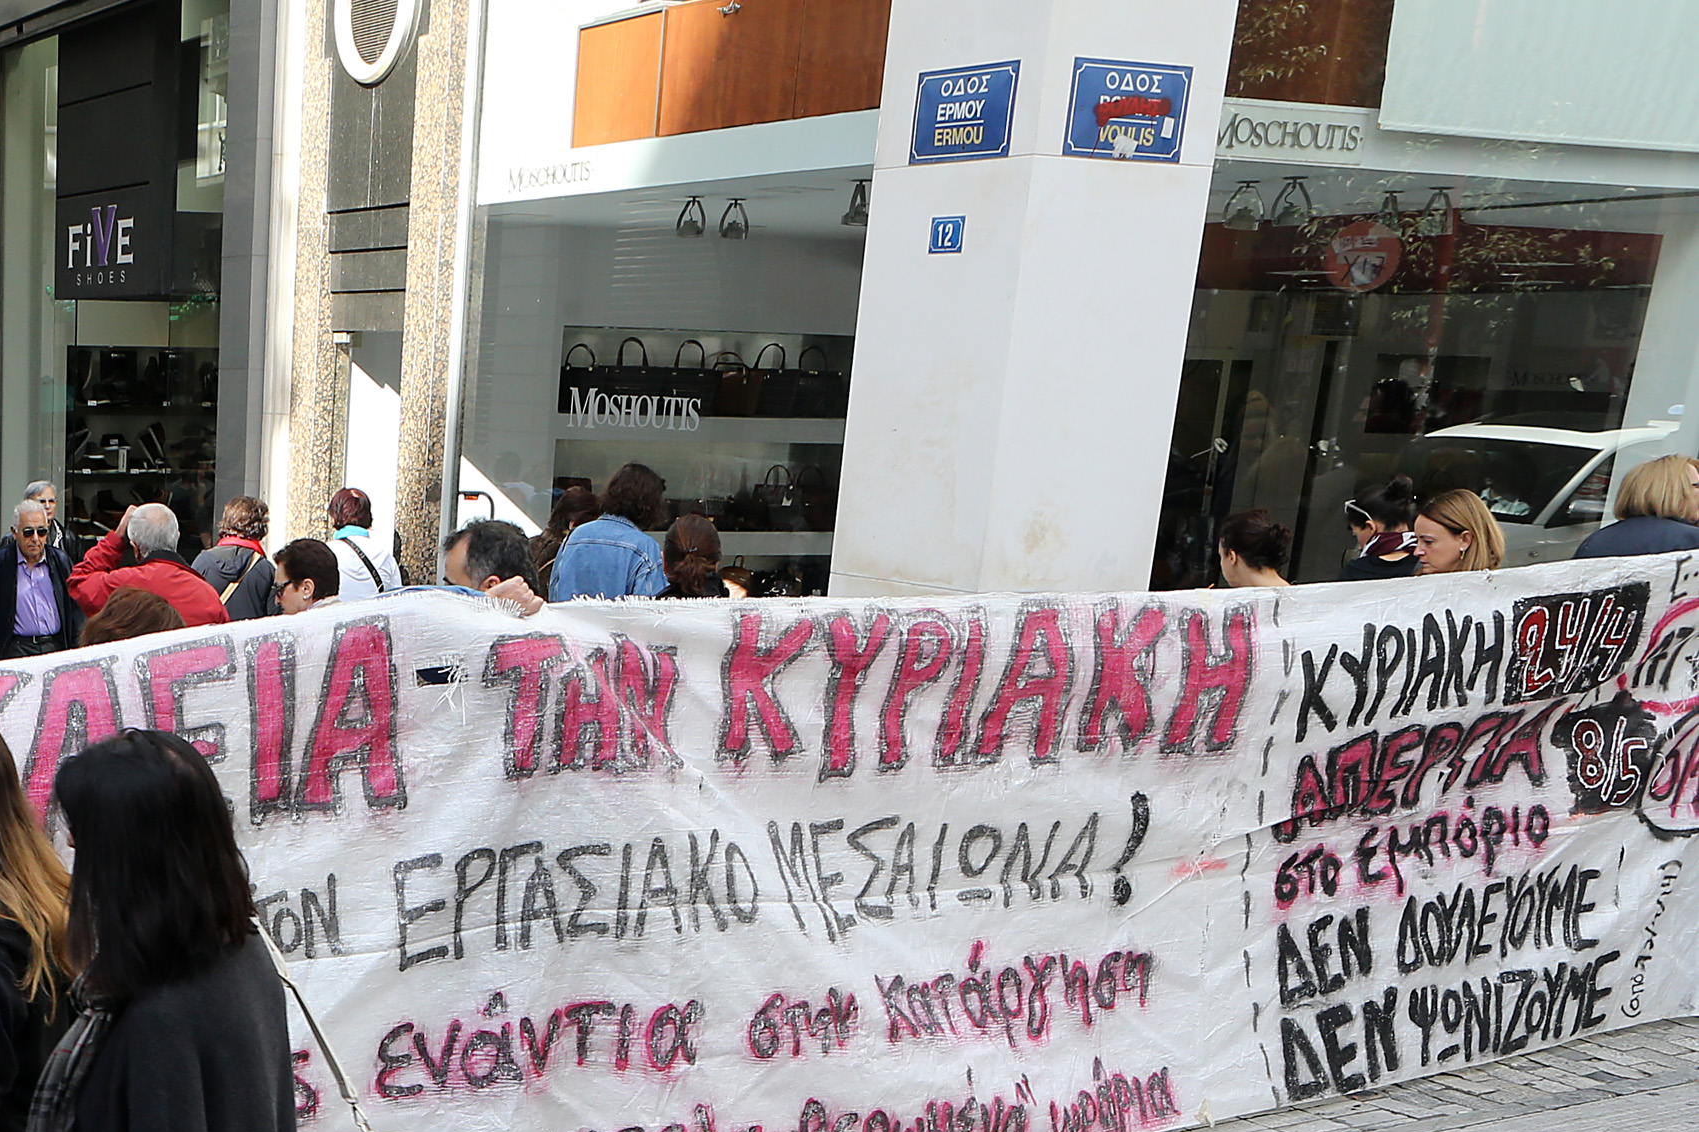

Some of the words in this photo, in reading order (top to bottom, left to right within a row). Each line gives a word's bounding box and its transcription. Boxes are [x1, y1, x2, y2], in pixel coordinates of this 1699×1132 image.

[936, 99, 985, 122] ΕΡΜΟΥ
[940, 75, 992, 97] ΟΔΟΣ
[1105, 71, 1164, 93] ΟΔΟΣ
[934, 126, 984, 147] ERMOU
[76, 269, 126, 286] SHOES
[936, 223, 954, 248] 12
[566, 386, 702, 432] MOSHOUTIS
[482, 632, 685, 780] ΤΗΝ
[715, 597, 1260, 784] ΚΥΡΙΑΚΗ
[1295, 608, 1506, 744] ΚΥΡΙΑΚΗ
[1517, 594, 1639, 698] 24/4
[1572, 715, 1649, 807] 8/5
[1355, 796, 1551, 896] εμπόριο
[393, 829, 761, 972] ΕΡΓΑΣΙΑΚΟ
[1277, 905, 1373, 1010] ΔΕΝ
[1398, 863, 1602, 976] ΔΟΥΛΕΥΟΥΜΕ
[372, 990, 707, 1100] ενάντια
[748, 984, 860, 1060] στην
[1280, 986, 1400, 1102] ΔΕΝ
